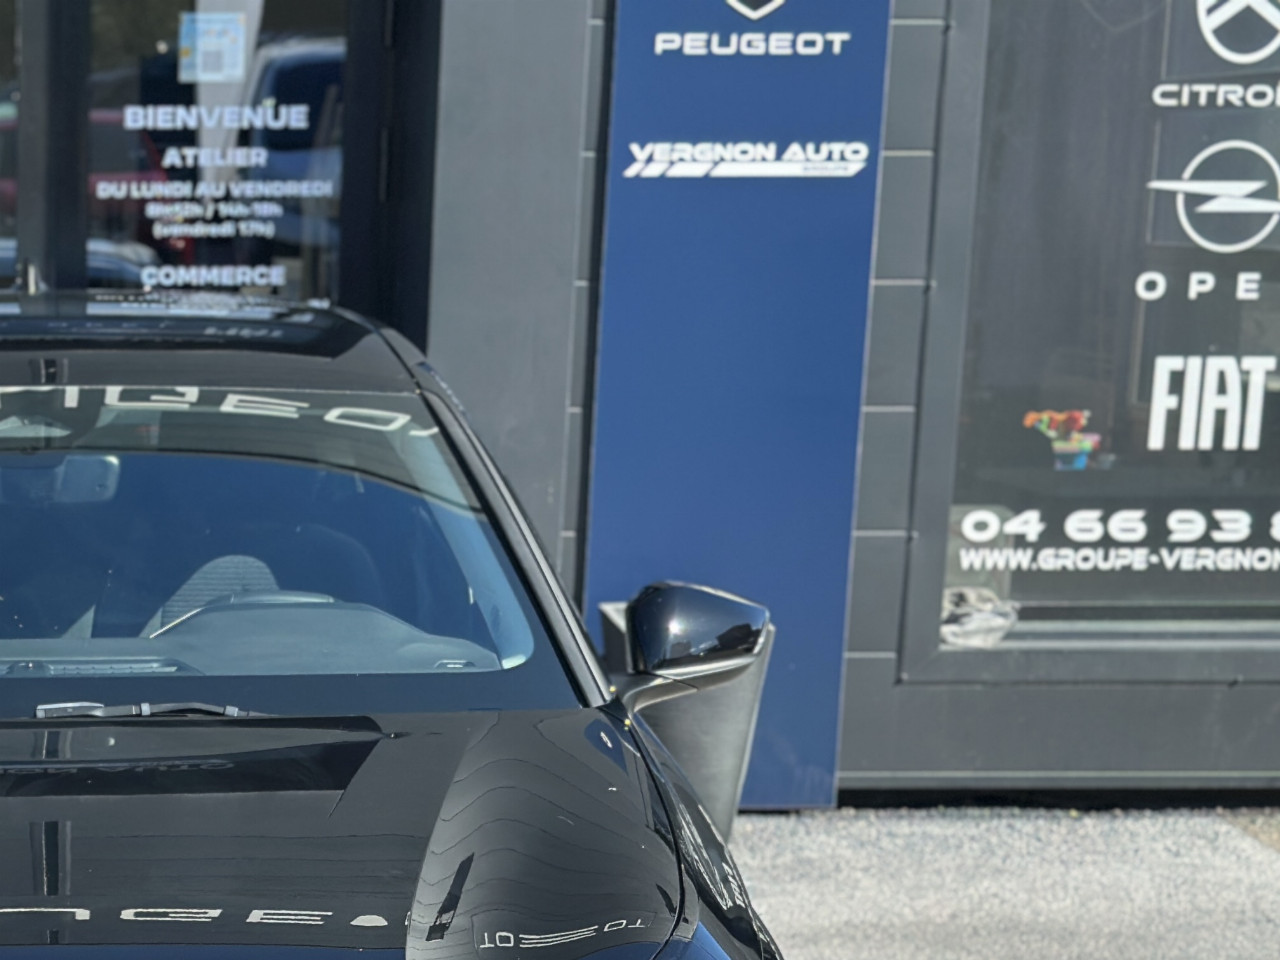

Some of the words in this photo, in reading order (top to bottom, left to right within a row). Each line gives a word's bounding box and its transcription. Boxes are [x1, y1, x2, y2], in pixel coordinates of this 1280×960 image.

[654, 32, 851, 55] PEUGEOT
[1152, 83, 1280, 107] CITRO
[123, 104, 310, 130] BIENVENUE
[161, 147, 269, 168] ATELIER
[628, 142, 776, 162] VERGNON
[781, 142, 869, 162] AUTO
[96, 181, 127, 199] DU
[130, 181, 193, 199] LUNDI
[195, 181, 227, 198] AU
[229, 181, 334, 198] VENDREDI
[140, 265, 287, 287] COMMERCE
[1147, 355, 1277, 451] FIAT
[961, 509, 1046, 542] 04
[1064, 509, 1148, 542] 66
[1166, 509, 1253, 542] 93
